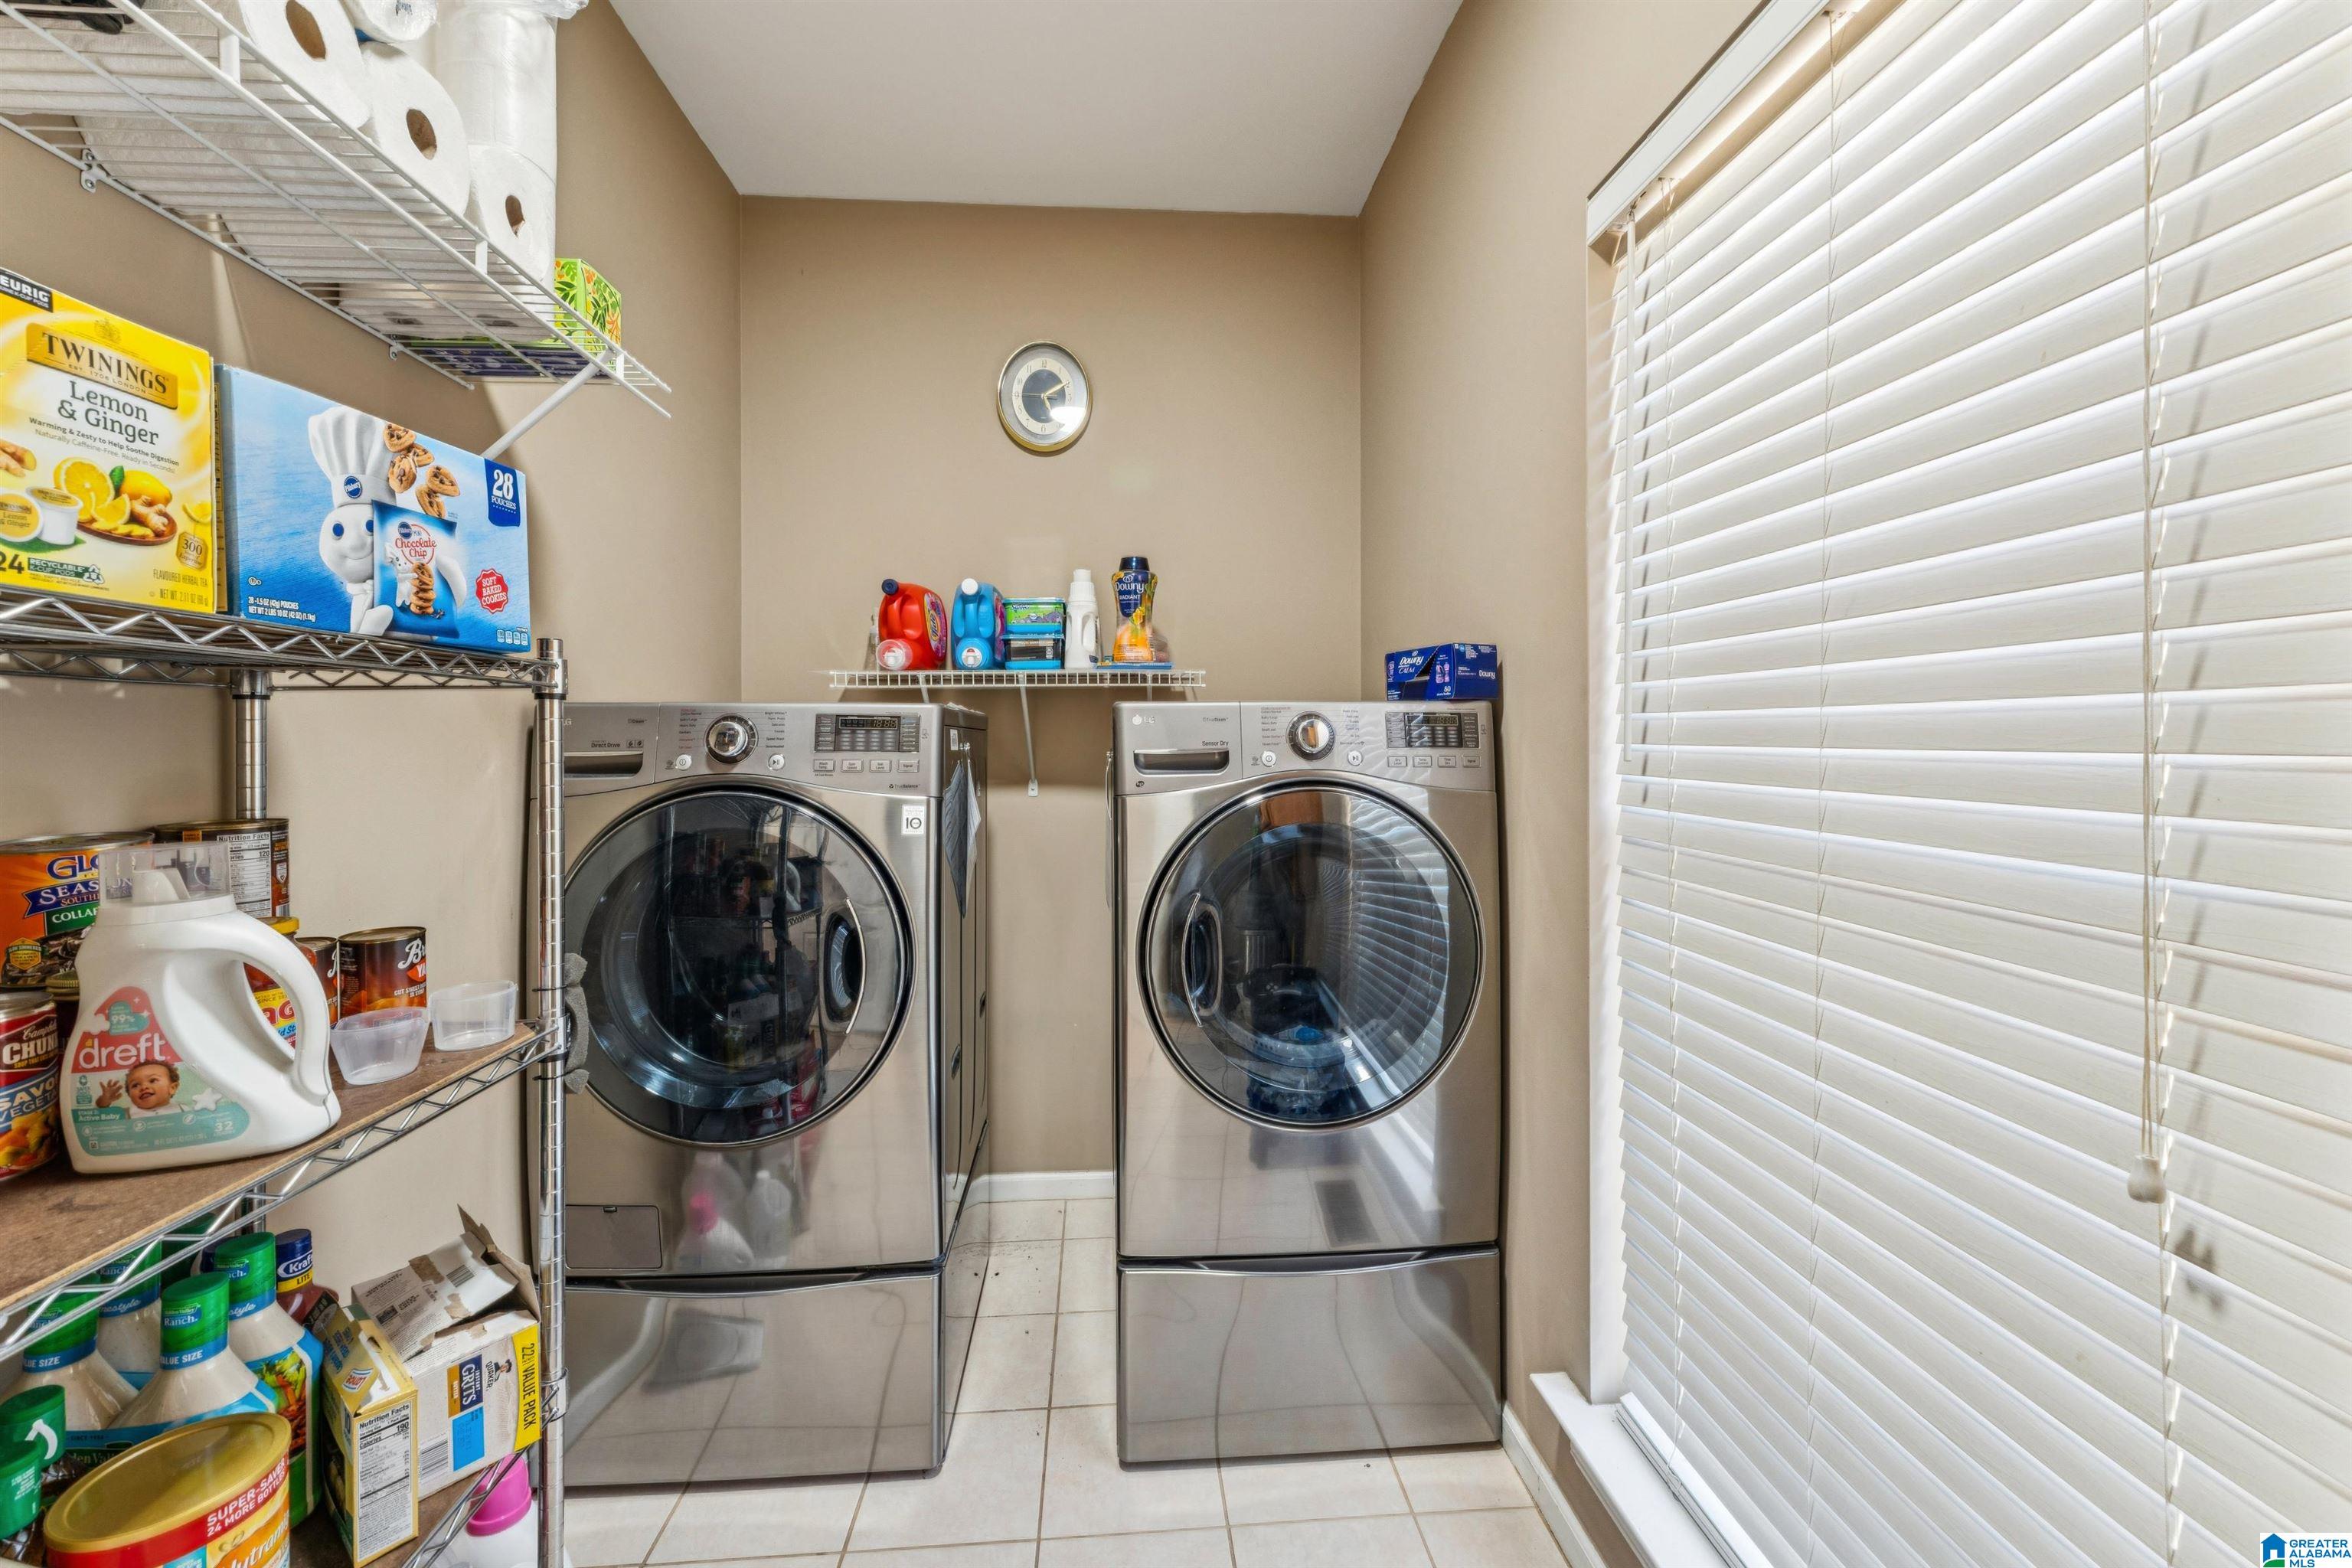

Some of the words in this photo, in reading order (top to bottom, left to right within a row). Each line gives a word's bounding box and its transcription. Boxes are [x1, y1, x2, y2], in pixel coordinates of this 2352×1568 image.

[0, 274, 49, 303] EURIG
[42, 332, 167, 394] TWININGS
[90, 371, 109, 381] 1706
[112, 378, 146, 394] LONDON
[70, 381, 148, 423] Lemon
[57, 400, 77, 421] &
[85, 408, 159, 445] Ginger
[29, 417, 67, 435] Warming
[77, 430, 97, 443] Zesty
[108, 439, 124, 450] Help
[126, 445, 149, 457] Soothe
[150, 452, 179, 466] Digestion
[35, 428, 70, 445] Naturally
[121, 452, 142, 464] Ready
[493, 469, 514, 500] 28
[492, 495, 516, 510] POUCHES
[182, 539, 202, 555] 300
[395, 537, 437, 549] Chocolate
[409, 547, 427, 560] Chip
[0, 552, 24, 574] 24
[30, 559, 83, 573] RECYCLABLE
[55, 568, 75, 577] PODS
[153, 569, 181, 583] FLAVOURED
[482, 577, 497, 587] SOFT
[1115, 582, 1145, 593] Downy
[159, 588, 168, 599] NET
[482, 584, 501, 596] BAKED
[281, 600, 299, 610] POUCHES
[482, 592, 506, 606] COOKIES
[1400, 656, 1424, 666] Downy
[1398, 666, 1416, 675] CALM
[1478, 669, 1496, 680] Downy
[906, 817, 922, 829] 10
[40, 880, 99, 905] SEAS
[60, 893, 100, 906] SOUTH
[258, 996, 276, 1004] SINCE
[2, 1031, 58, 1065] CHUN
[79, 1032, 166, 1069] dreft
[0, 1073, 58, 1110] SAVO
[0, 1091, 57, 1122] VEGETA
[101, 1113, 120, 1122] Baby
[214, 1120, 234, 1132] 32
[296, 1274, 311, 1285] LITE
[100, 1298, 142, 1313] estyle
[229, 1303, 256, 1317] style
[181, 1350, 204, 1363] SIZE
[522, 1343, 535, 1360] 22
[24, 1358, 37, 1367] LUE
[39, 1356, 60, 1367] SIZE
[461, 1364, 477, 1405] GRITS
[522, 1364, 535, 1400] VALUE
[359, 1411, 390, 1429] Nutrition
[391, 1403, 410, 1416] Facts
[524, 1400, 537, 1430] PACK
[397, 1421, 409, 1432] 190
[359, 1436, 382, 1449] Calories
[207, 1457, 286, 1527] SUPER-SAVER
[207, 1524, 222, 1537] 24
[225, 1501, 256, 1527] MORE
